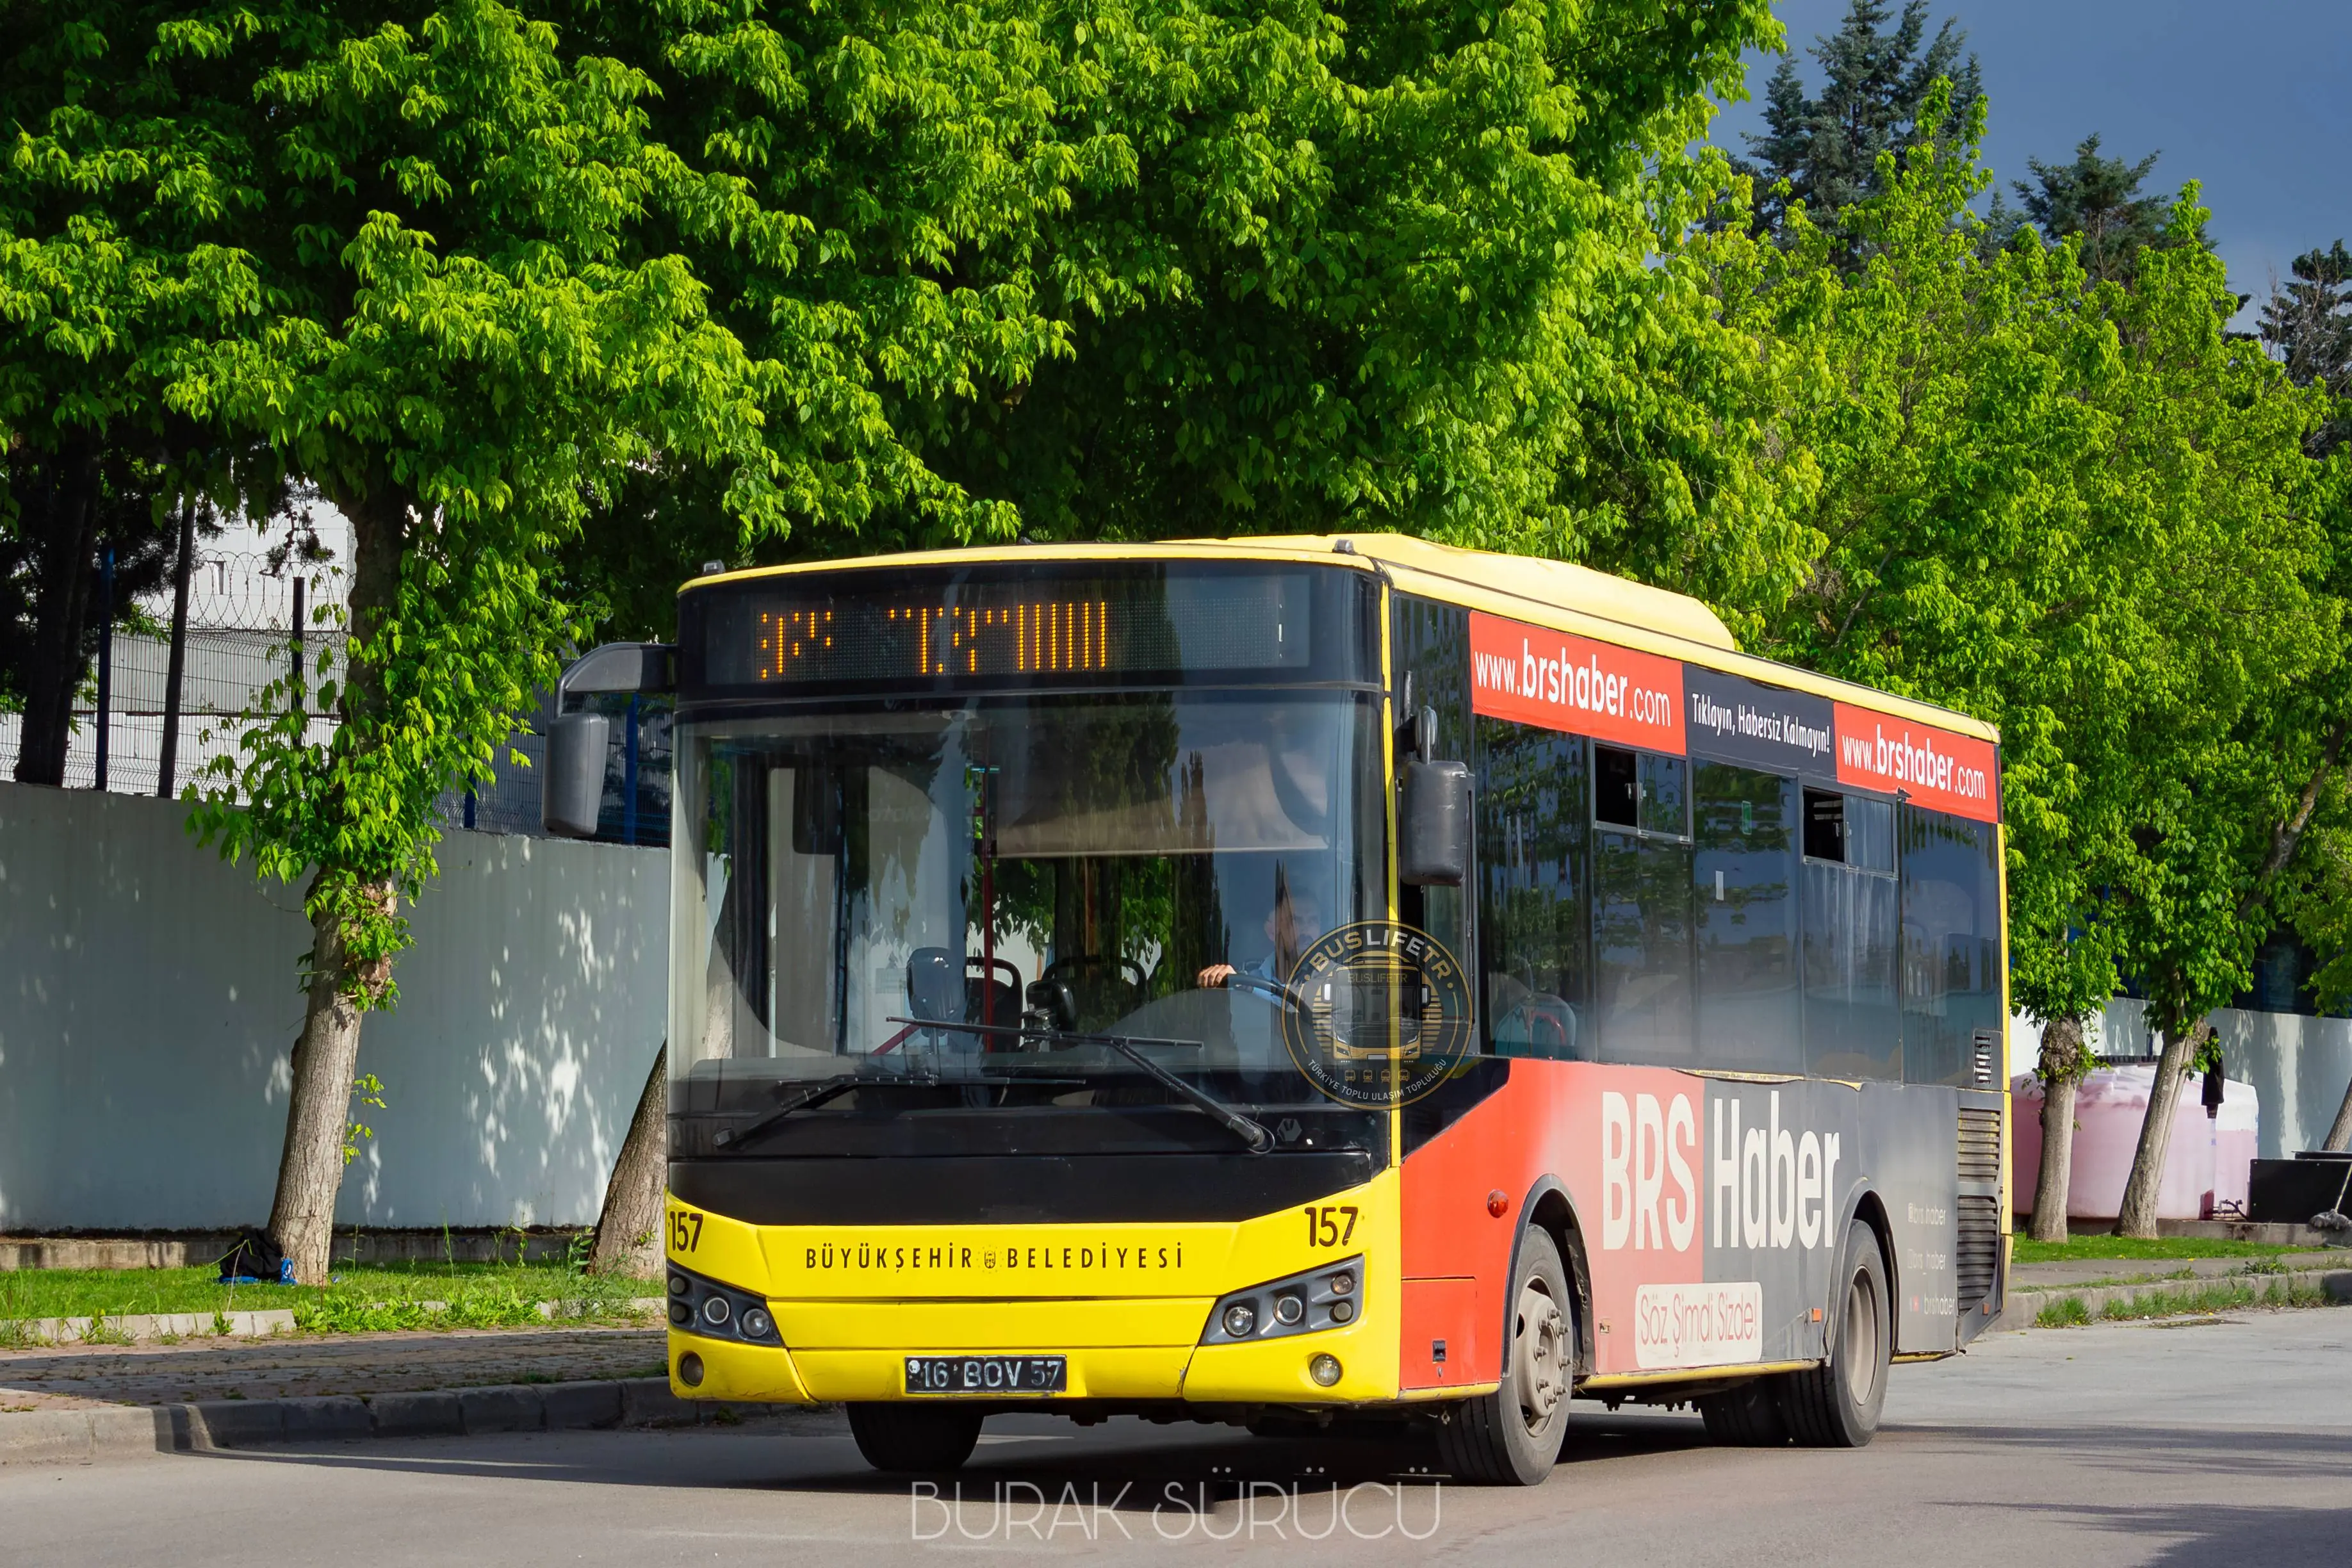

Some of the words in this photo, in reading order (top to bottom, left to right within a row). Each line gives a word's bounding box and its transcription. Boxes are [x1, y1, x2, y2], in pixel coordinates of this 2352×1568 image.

[1474, 638, 1670, 727] www.brshaber.com
[1692, 693, 1736, 737] Tıklayın,
[1738, 704, 1781, 742] Habersiz
[1783, 714, 1830, 758] Kalmayın!
[1842, 724, 1986, 799] www.brshaber.com
[1603, 1091, 1695, 1252] BRS
[1713, 1091, 1840, 1250] Haber
[669, 1211, 704, 1253] 157
[806, 1242, 972, 1273] BÜYÜKŞEHİR
[1007, 1241, 1182, 1269] BELEDİYESİ
[1304, 1206, 1359, 1247] 157
[1640, 1293, 1668, 1346] Söz
[1673, 1293, 1713, 1359] Şimdi
[1717, 1291, 1758, 1342] Sizde!
[923, 1361, 949, 1388] 16
[963, 1361, 1022, 1387] BOV
[1031, 1360, 1062, 1387] 57
